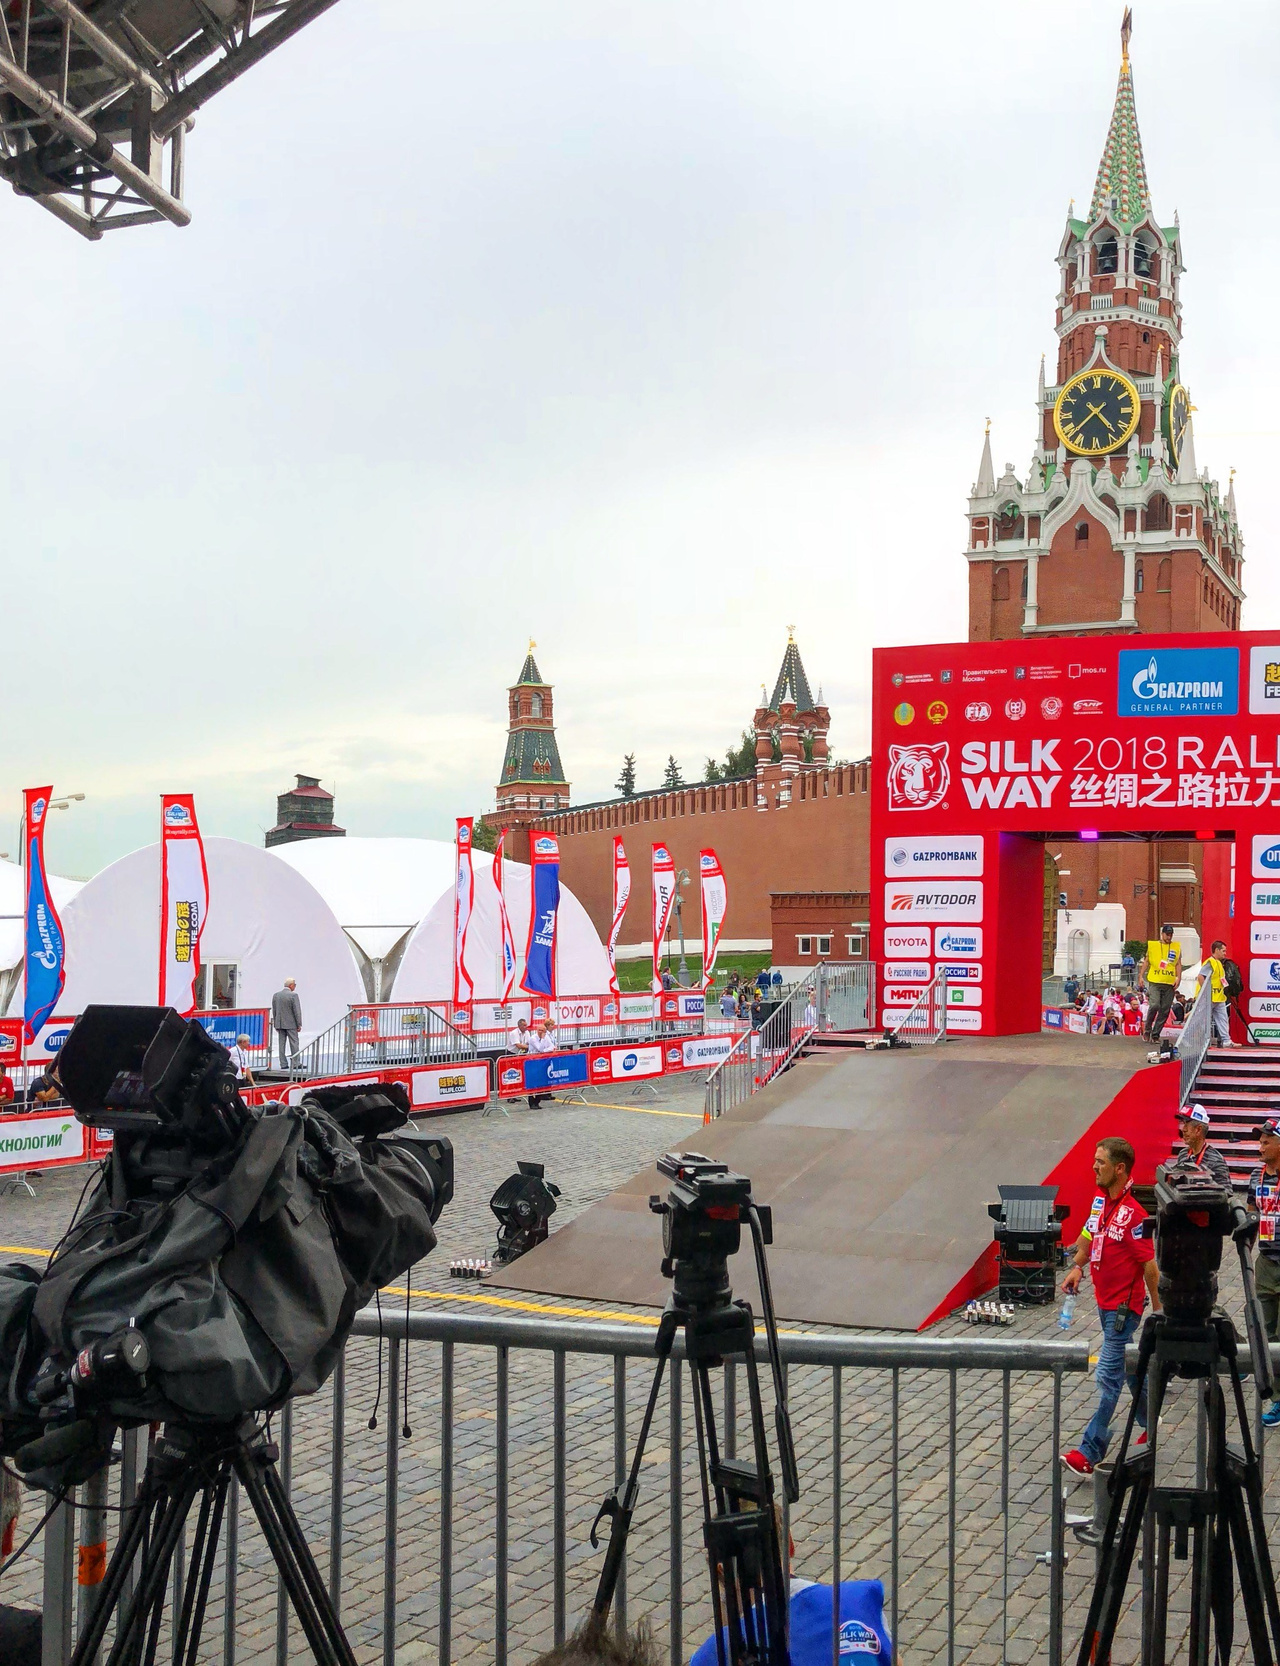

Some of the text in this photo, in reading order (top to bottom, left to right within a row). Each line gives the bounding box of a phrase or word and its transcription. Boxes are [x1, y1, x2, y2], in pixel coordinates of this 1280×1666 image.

[962, 667, 1008, 677] Правительство
[962, 676, 986, 684] Москвы
[1158, 682, 1223, 698] GAZPROM
[967, 706, 988, 717] FIA
[1131, 702, 1223, 712] GENERAL PARTNER
[961, 738, 1062, 773] SILK
[1073, 736, 1168, 771] 2018
[961, 776, 1064, 809] WAY
[913, 851, 977, 861] GAZPROMBANK
[916, 895, 976, 905] AVTODOR
[37, 904, 53, 951] GAZPROM
[888, 938, 928, 946] TOYOTA
[1162, 969, 1175, 977] LIVE
[494, 1011, 512, 1021] SGS
[1129, 1023, 1140, 1032] TV
[1109, 1224, 1125, 1235] SILK
[1108, 1231, 1124, 1241] WAY
[858, 1631, 873, 1639] WAY
